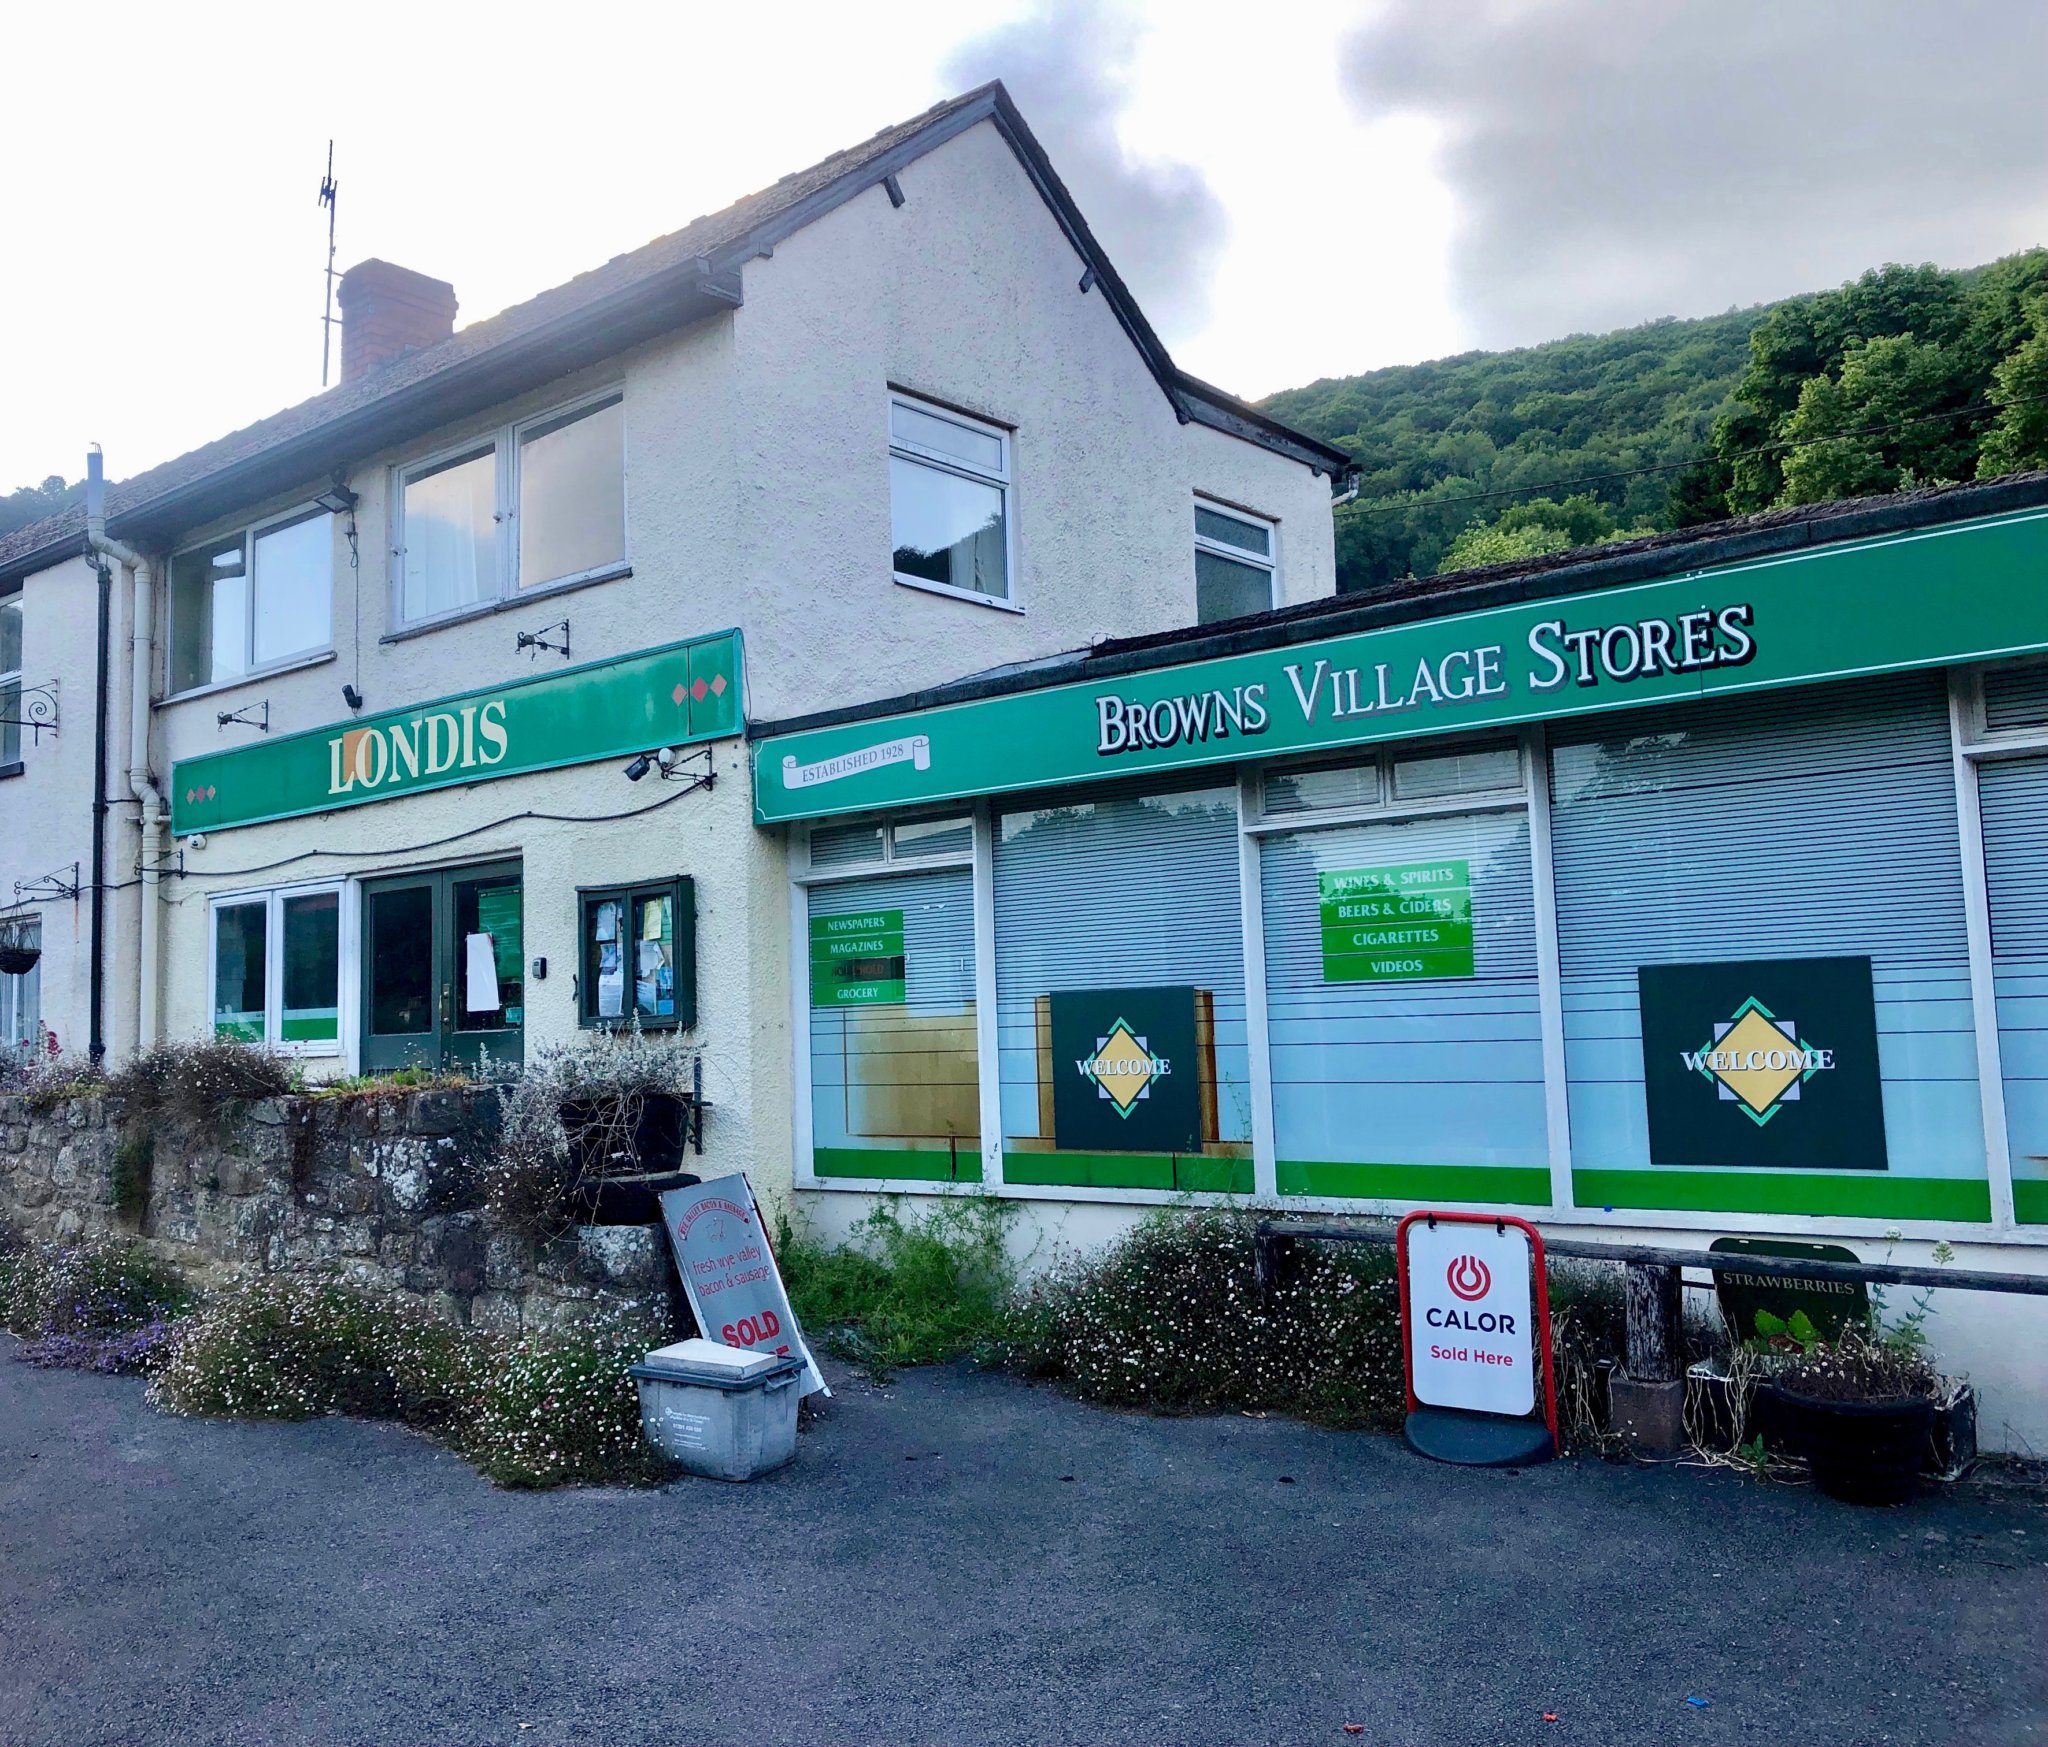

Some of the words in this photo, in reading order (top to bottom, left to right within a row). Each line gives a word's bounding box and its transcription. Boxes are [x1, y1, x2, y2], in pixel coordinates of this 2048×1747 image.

[1096, 684, 1268, 755] BROWNS
[1284, 645, 1506, 723] VILLAGE
[1527, 603, 1756, 691] STORES
[328, 700, 508, 795] LONDIS
[802, 750, 878, 782] ESTABLISHED
[881, 745, 904, 761] 1928
[1333, 874, 1379, 889] WINES
[1383, 873, 1396, 886] &
[1400, 868, 1454, 884] SPIRITS
[1338, 903, 1379, 918] BEERS
[1382, 902, 1395, 915] &
[1399, 898, 1451, 914] CIDERS
[827, 917, 885, 931] NEWSPAPERS
[830, 940, 884, 954] MAGAZINES
[1352, 929, 1439, 946] CIGARETTES
[1370, 959, 1423, 973] VIDEOS
[837, 988, 879, 999] GROCERY
[1075, 1058, 1172, 1076] WELCOME
[1679, 1049, 1836, 1072] WELCOME
[692, 1257, 716, 1275] fresh
[718, 1253, 736, 1270] wye
[736, 1245, 761, 1262] valley
[726, 1272, 734, 1287] &
[735, 1264, 770, 1285] sausage
[1723, 1272, 1855, 1295] STRAWBERRIES
[722, 1310, 780, 1349] SOLD
[1426, 1308, 1516, 1335] CALOR
[1431, 1345, 1468, 1361] Sold
[1474, 1349, 1513, 1366] Here
